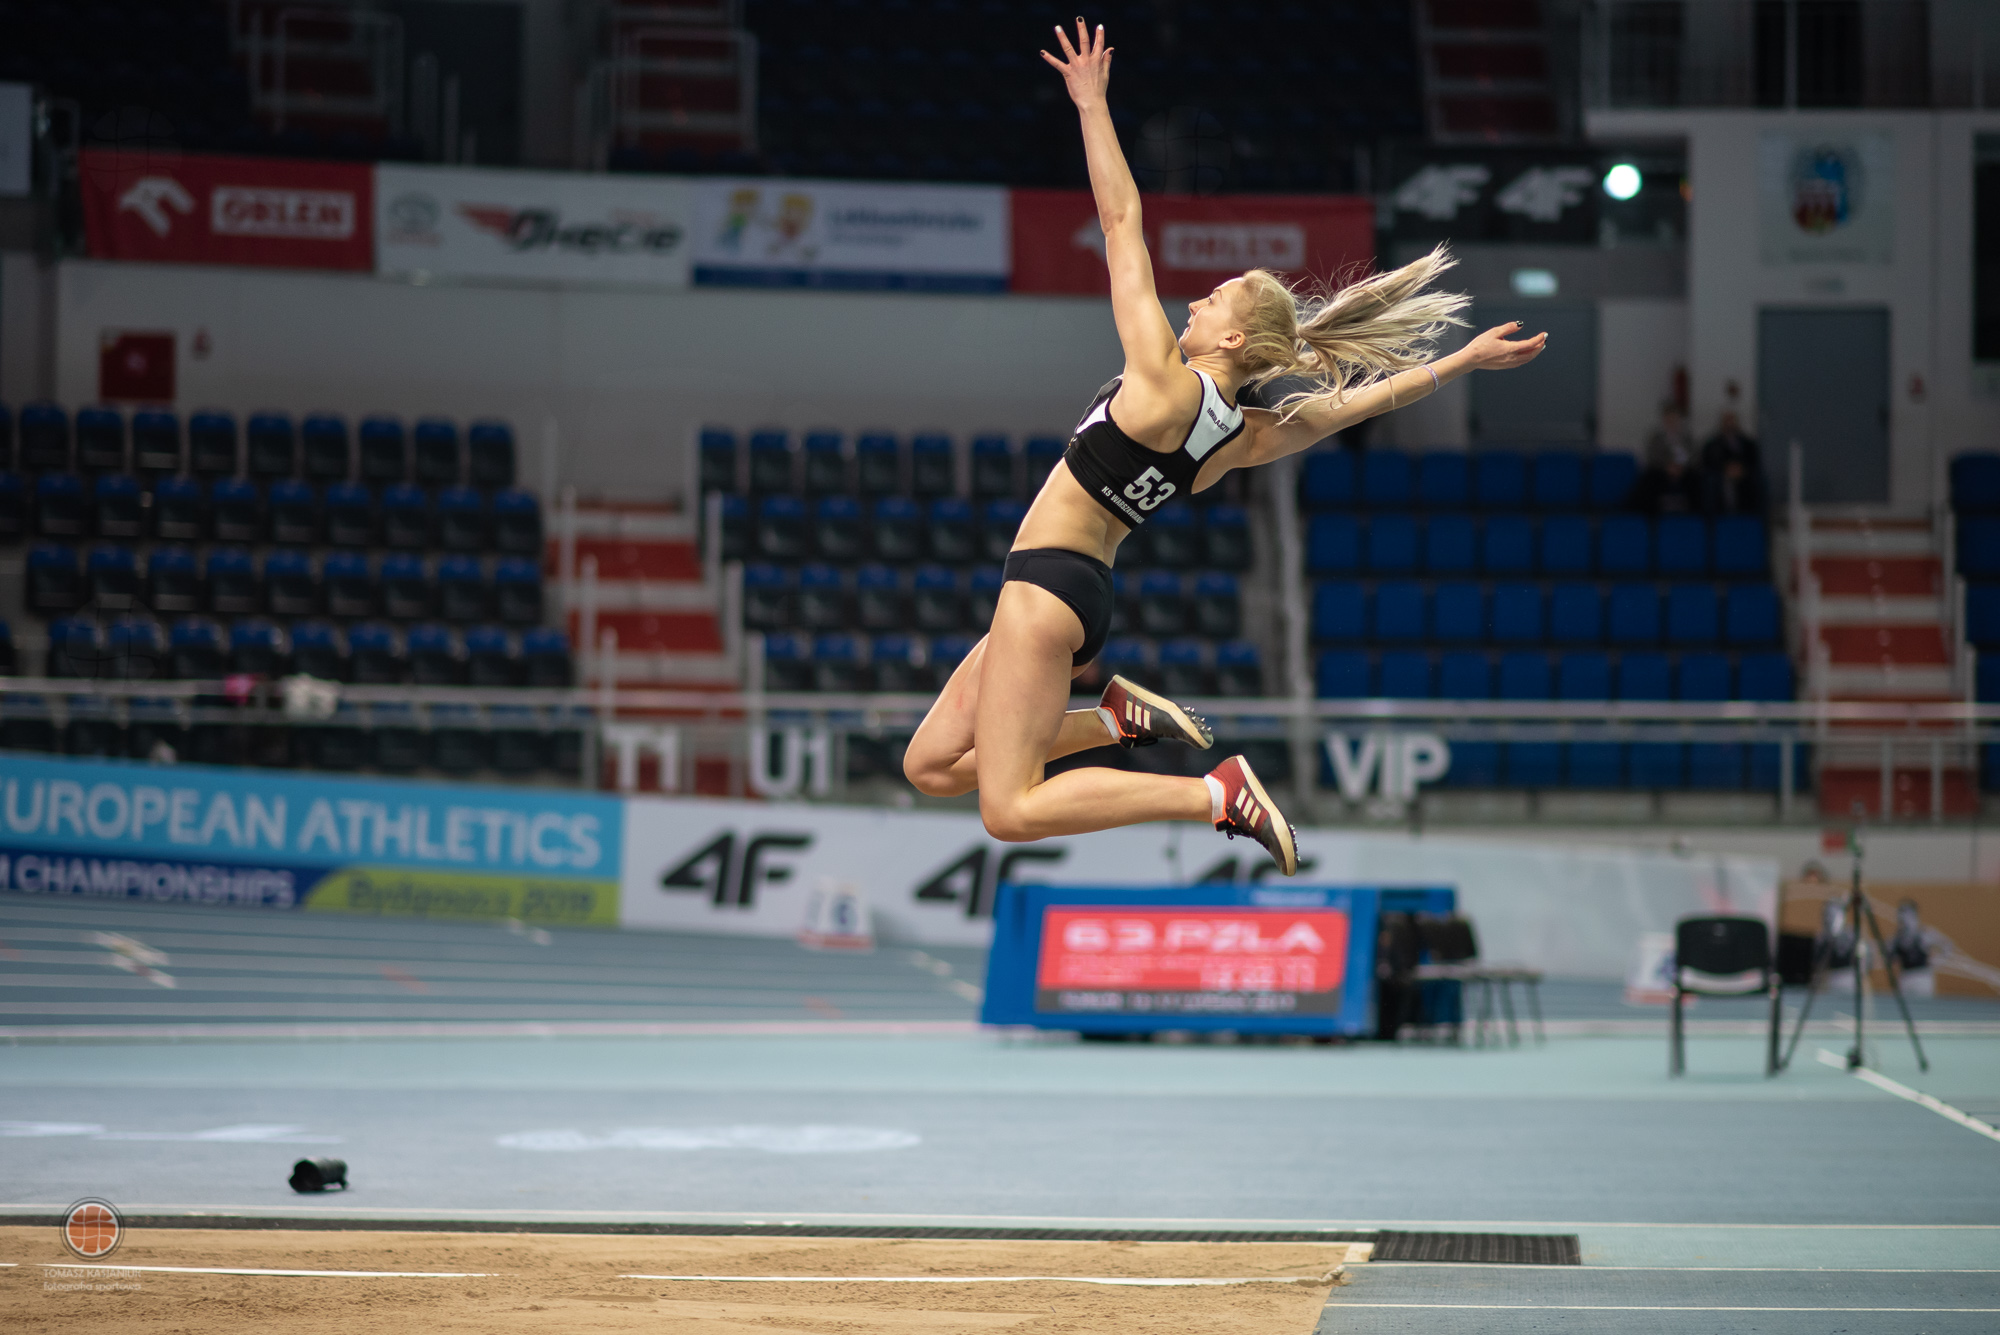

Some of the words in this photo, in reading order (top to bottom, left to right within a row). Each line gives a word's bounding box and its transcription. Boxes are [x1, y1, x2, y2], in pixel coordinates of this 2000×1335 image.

[220, 192, 346, 233] ORLEN
[1101, 485, 1113, 497] KS
[1123, 466, 1176, 511] 53
[1324, 730, 1451, 803] VIP
[0, 776, 287, 850] UROPEAN
[299, 795, 602, 869] ATHLETICS
[15, 853, 295, 909] CHAMPIONSHIPS
[661, 829, 816, 908] 4F
[1163, 918, 1326, 955] PZLA
